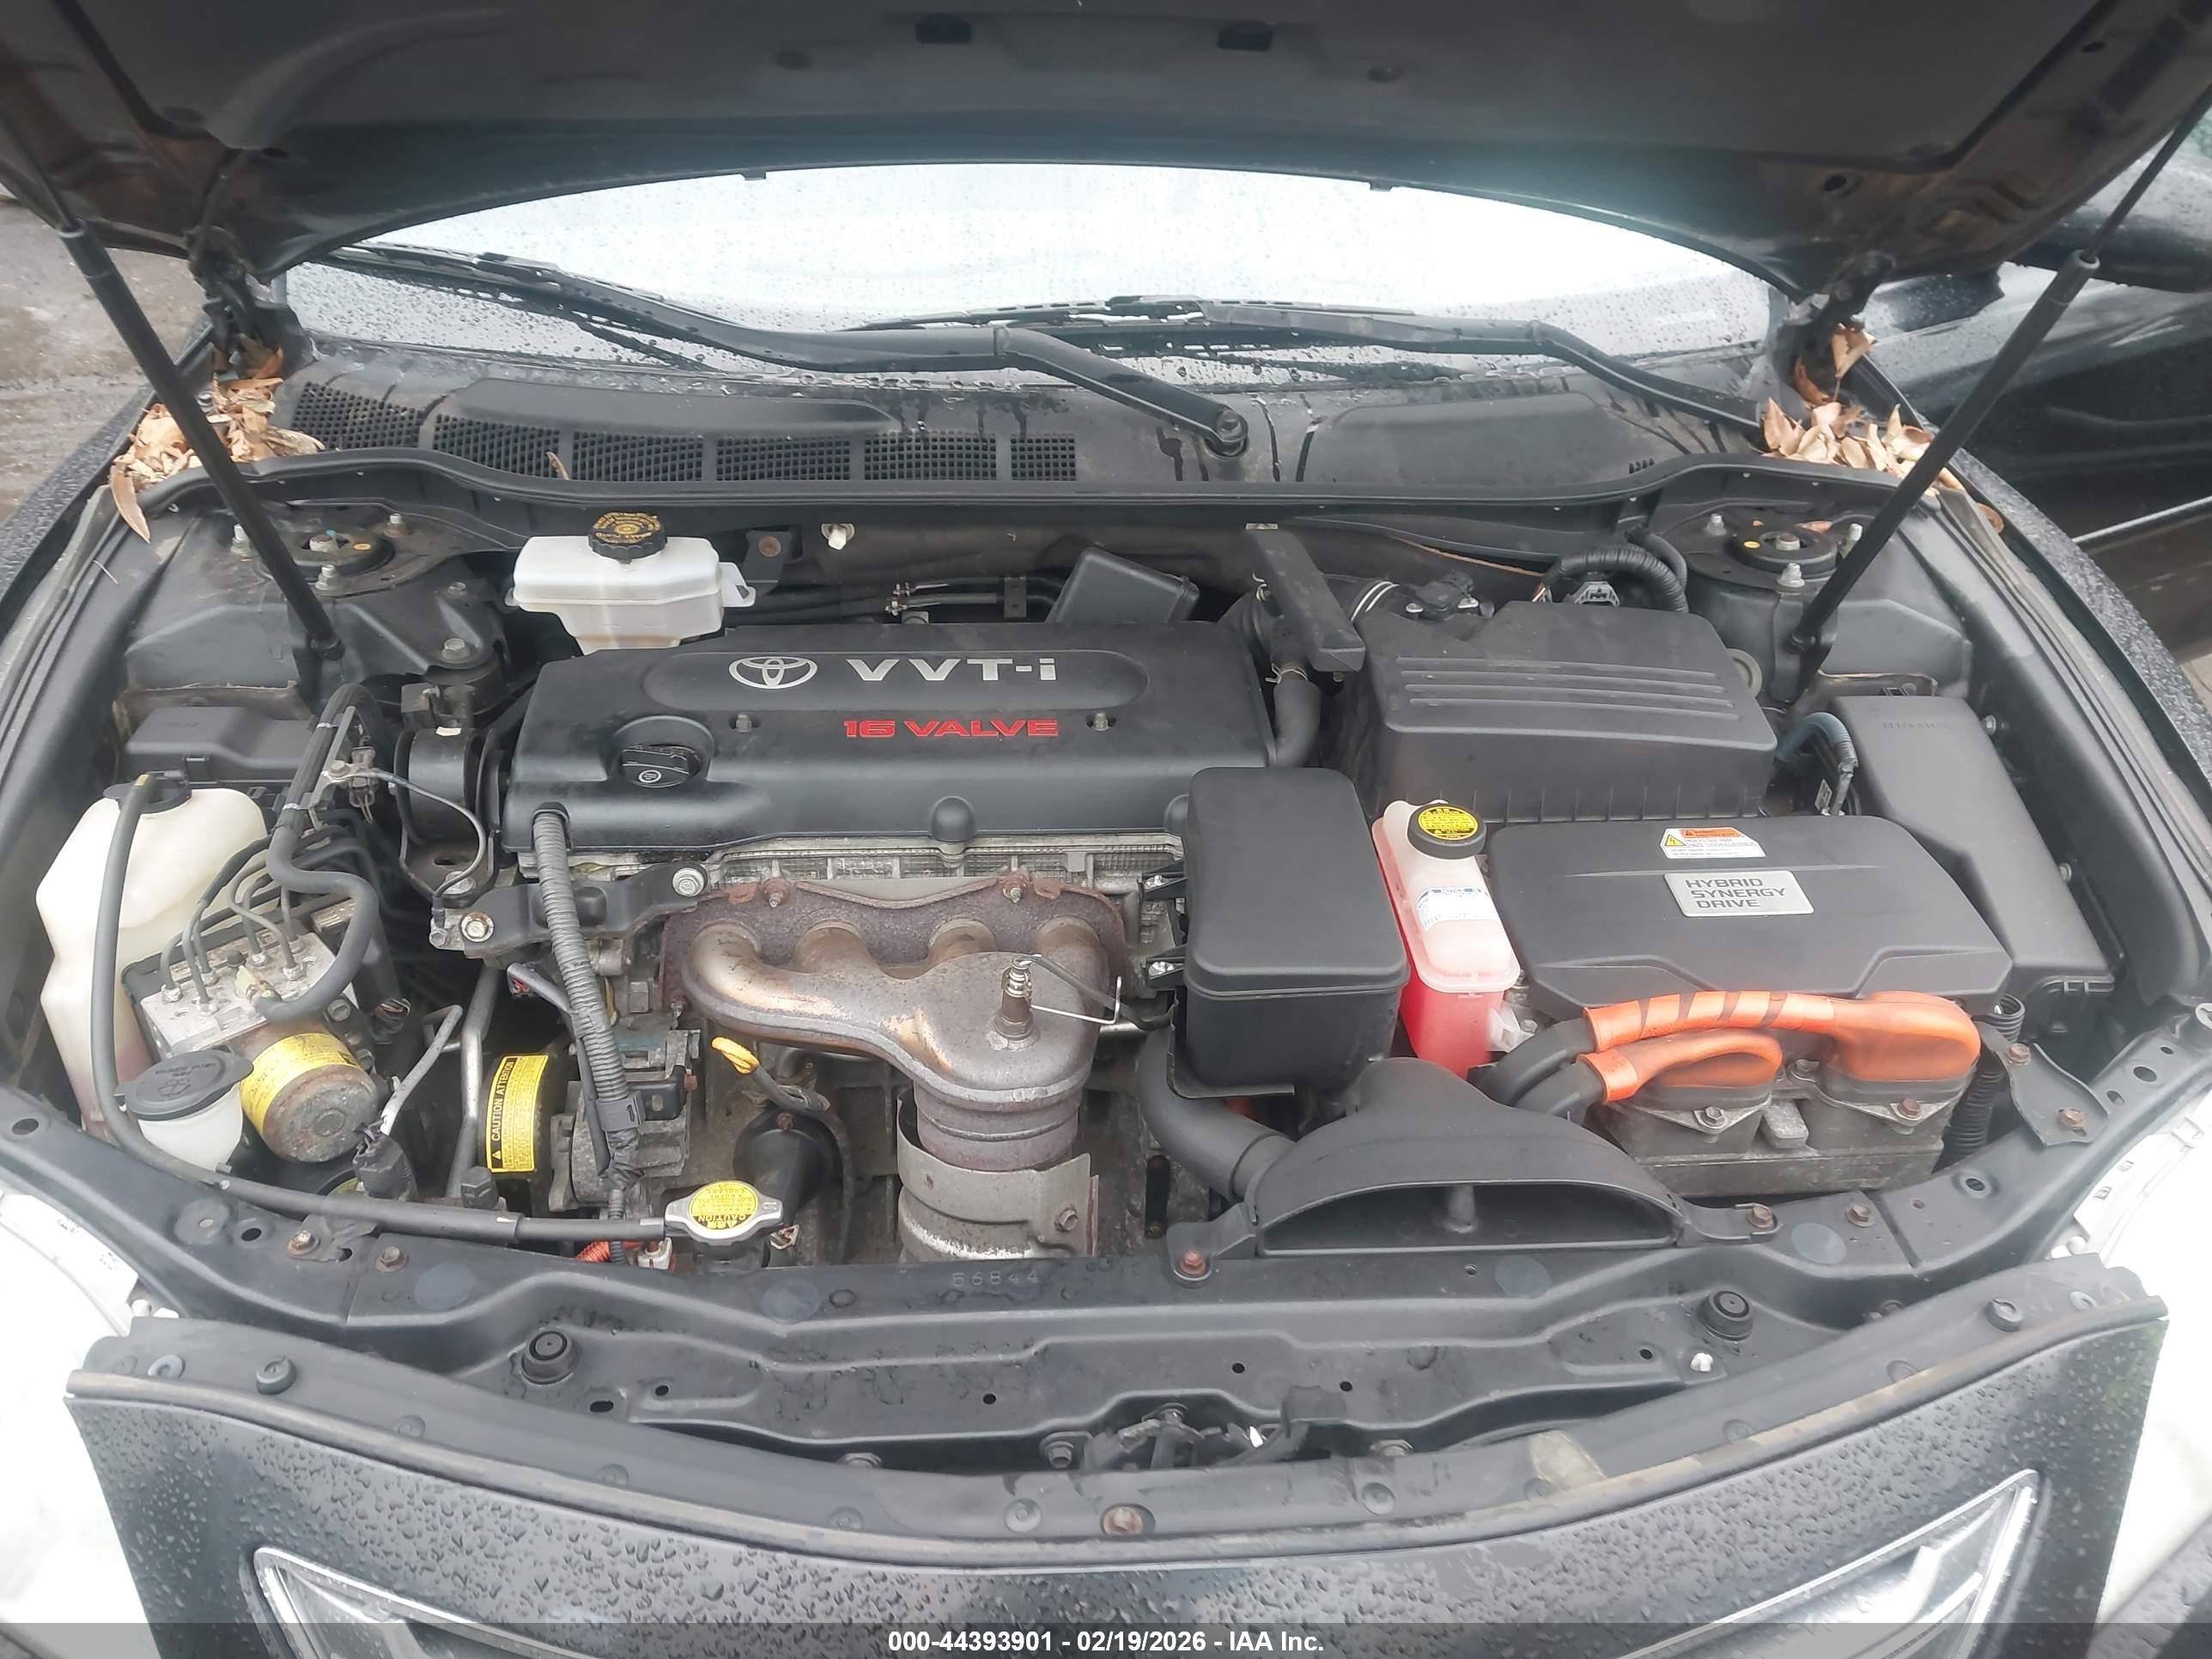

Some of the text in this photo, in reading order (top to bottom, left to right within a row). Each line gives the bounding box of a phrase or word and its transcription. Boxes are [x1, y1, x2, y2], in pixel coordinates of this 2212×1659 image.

[846, 658, 1056, 682] VVT-i
[843, 719, 1059, 737] 16 VALVE
[1685, 878, 1763, 889] HYBRID
[1691, 888, 1785, 899] SYNERGY
[1697, 899, 1760, 908] DRIVE
[491, 1061, 514, 1142] CAUTION ATTENTION
